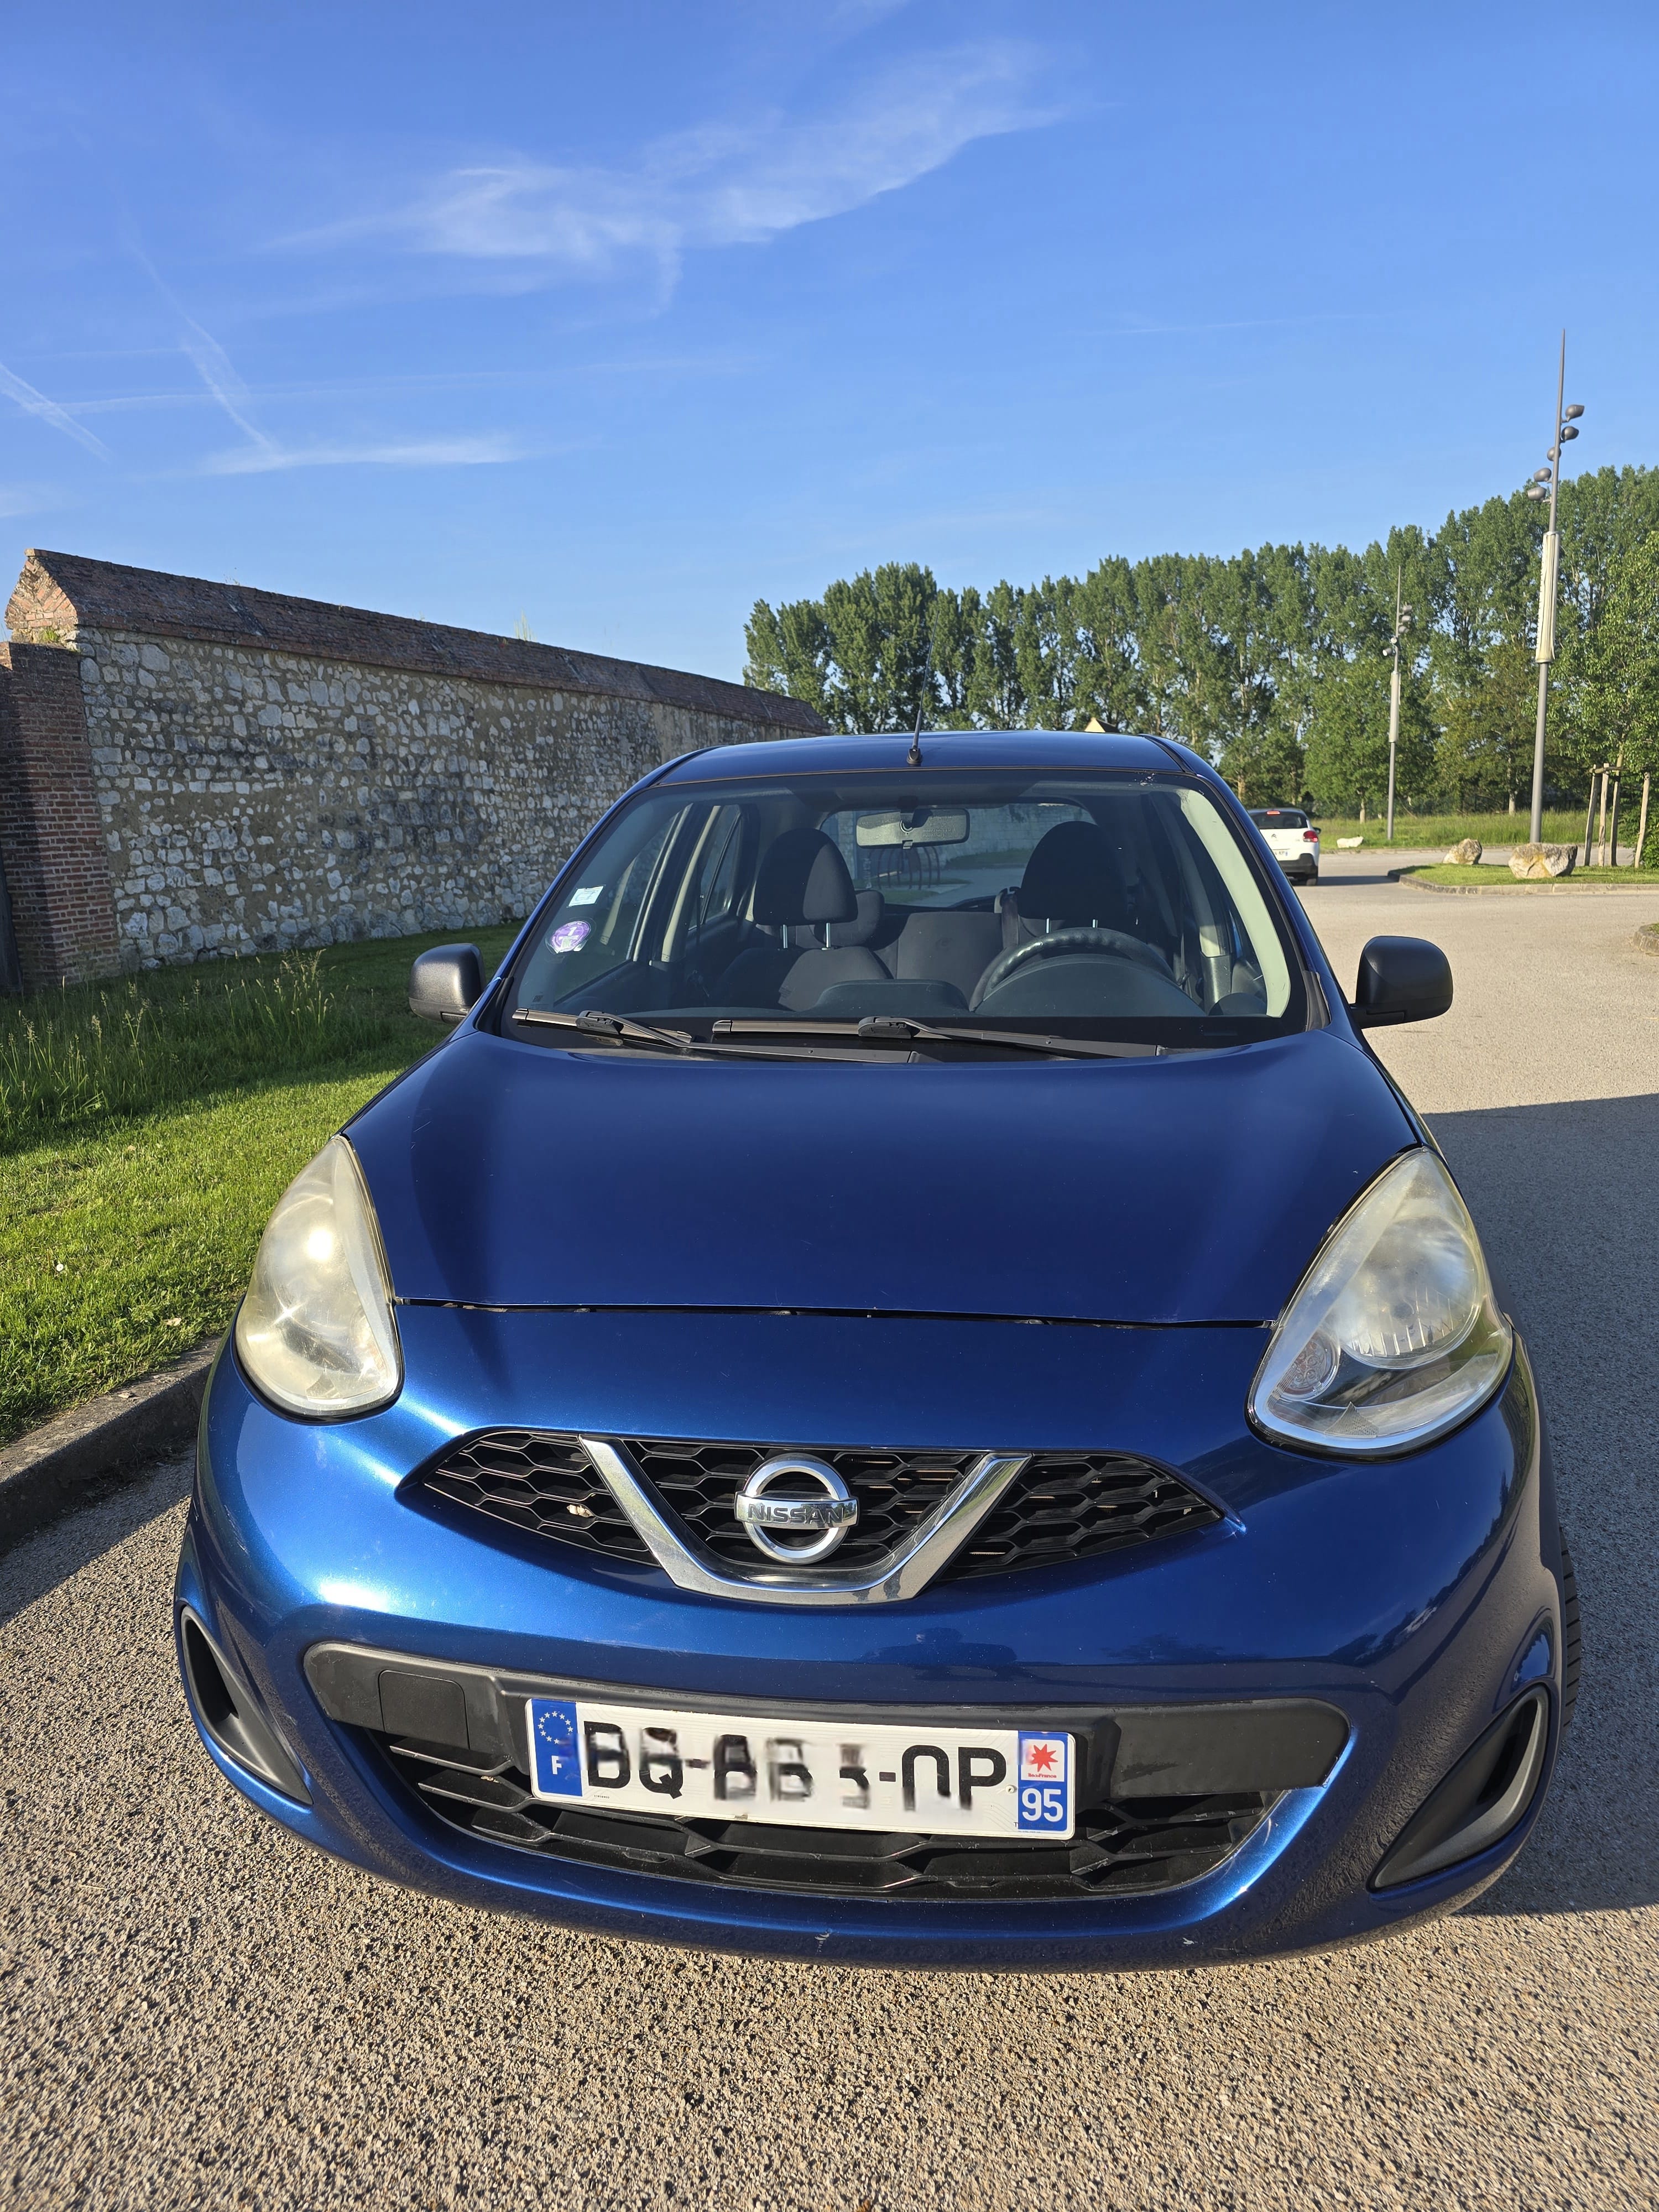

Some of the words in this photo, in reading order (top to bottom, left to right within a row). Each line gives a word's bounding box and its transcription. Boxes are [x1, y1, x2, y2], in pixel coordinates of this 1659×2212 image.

[568, 926, 577, 936] 1
[748, 1504, 843, 1524] NISSAN
[551, 1755, 564, 1775] F
[1022, 1788, 1063, 1822] 95
